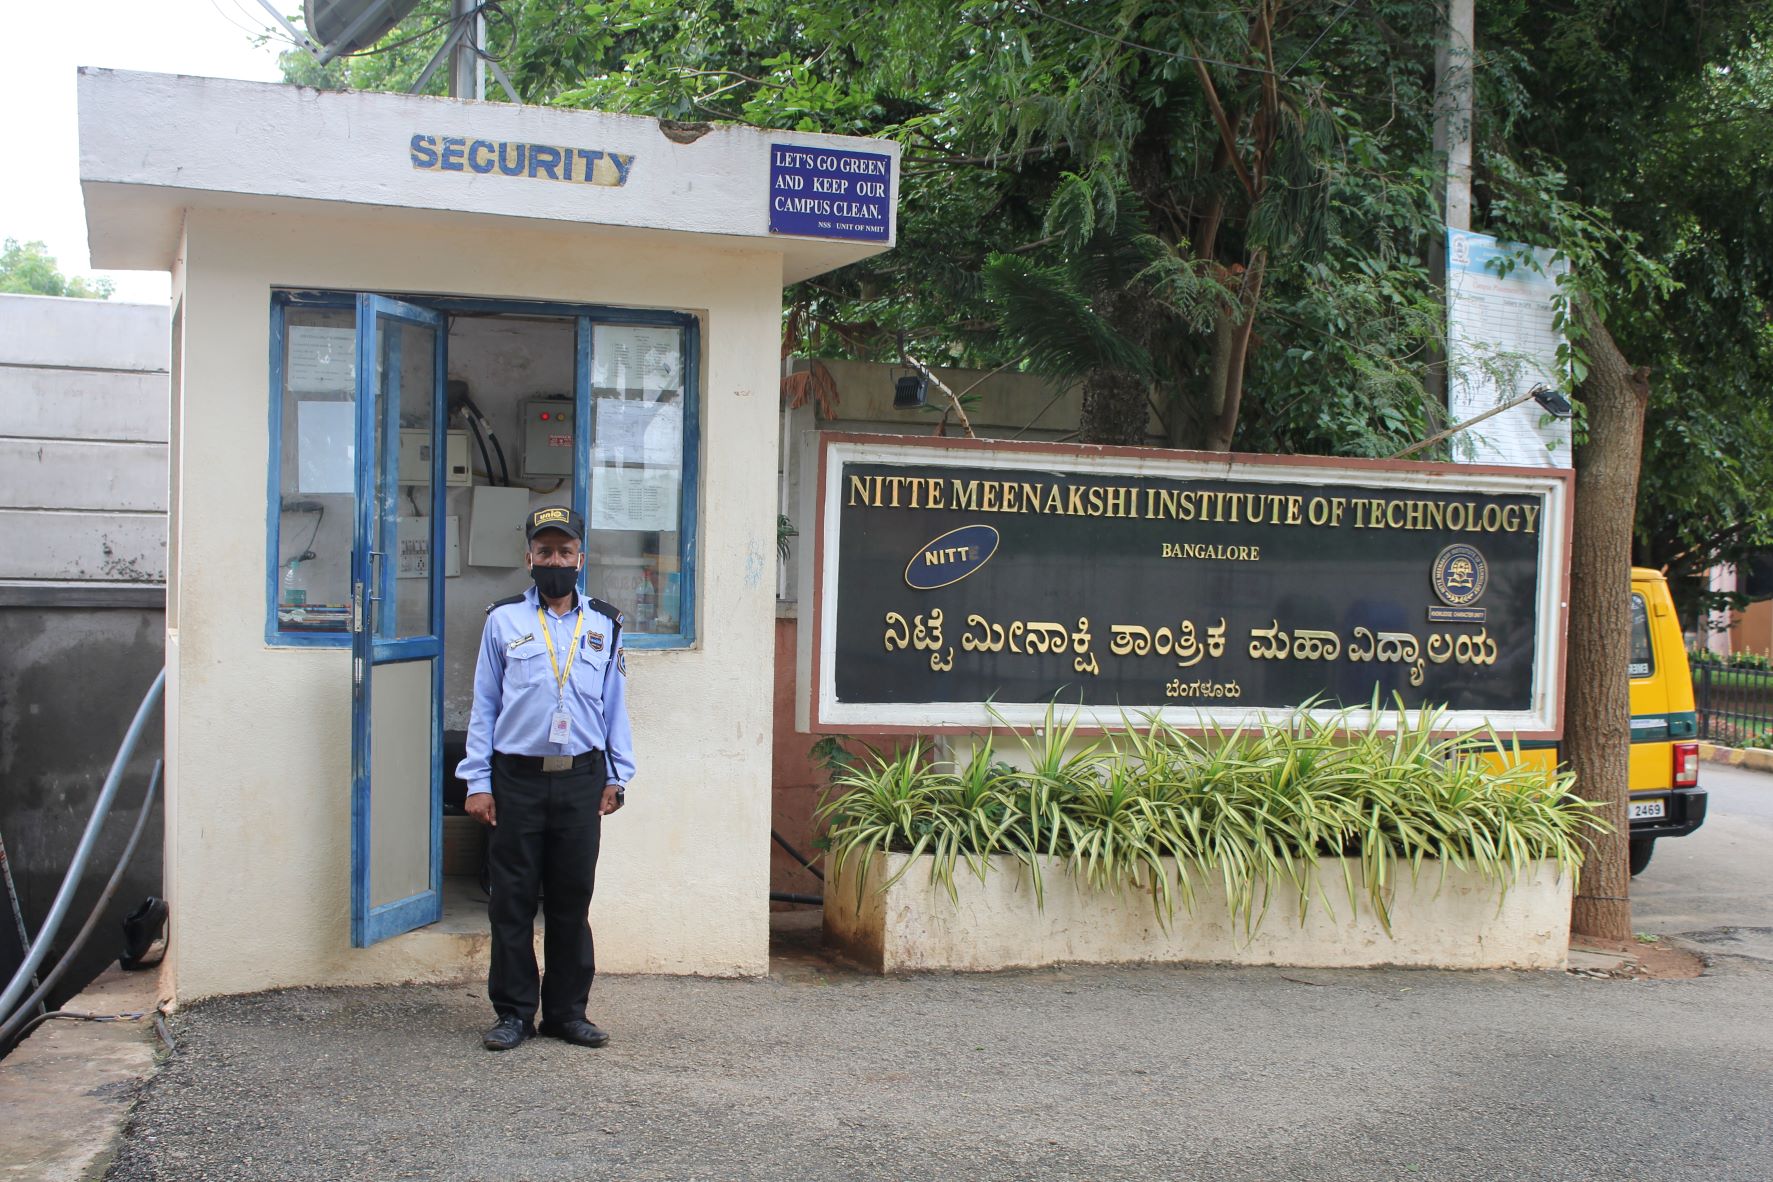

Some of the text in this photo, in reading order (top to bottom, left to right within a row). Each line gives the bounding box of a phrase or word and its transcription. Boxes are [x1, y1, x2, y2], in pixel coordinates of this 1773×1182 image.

[411, 134, 635, 187] SECURITY
[776, 151, 885, 176] LET'S GO GREEN
[775, 174, 885, 197] AND KEEP OUR
[775, 196, 882, 219] CAMPUS CLEAN.
[818, 221, 884, 233] NSS UNIT OF NMIT
[848, 475, 1540, 533] NITTE MEENAKSHI INSTITUTE OF TECHNOLOGY
[1161, 543, 1260, 560] BANGALORE
[884, 608, 953, 671] ನಿಟ್ಟೆ
[962, 614, 1099, 675] ಮೀನಾಕ್ಷಿ
[1110, 617, 1226, 667] ತಾಂತ್ರಿಕ
[1166, 678, 1241, 697] ಬೆಂಗಳೂರು
[1635, 804, 1661, 816] 2469
